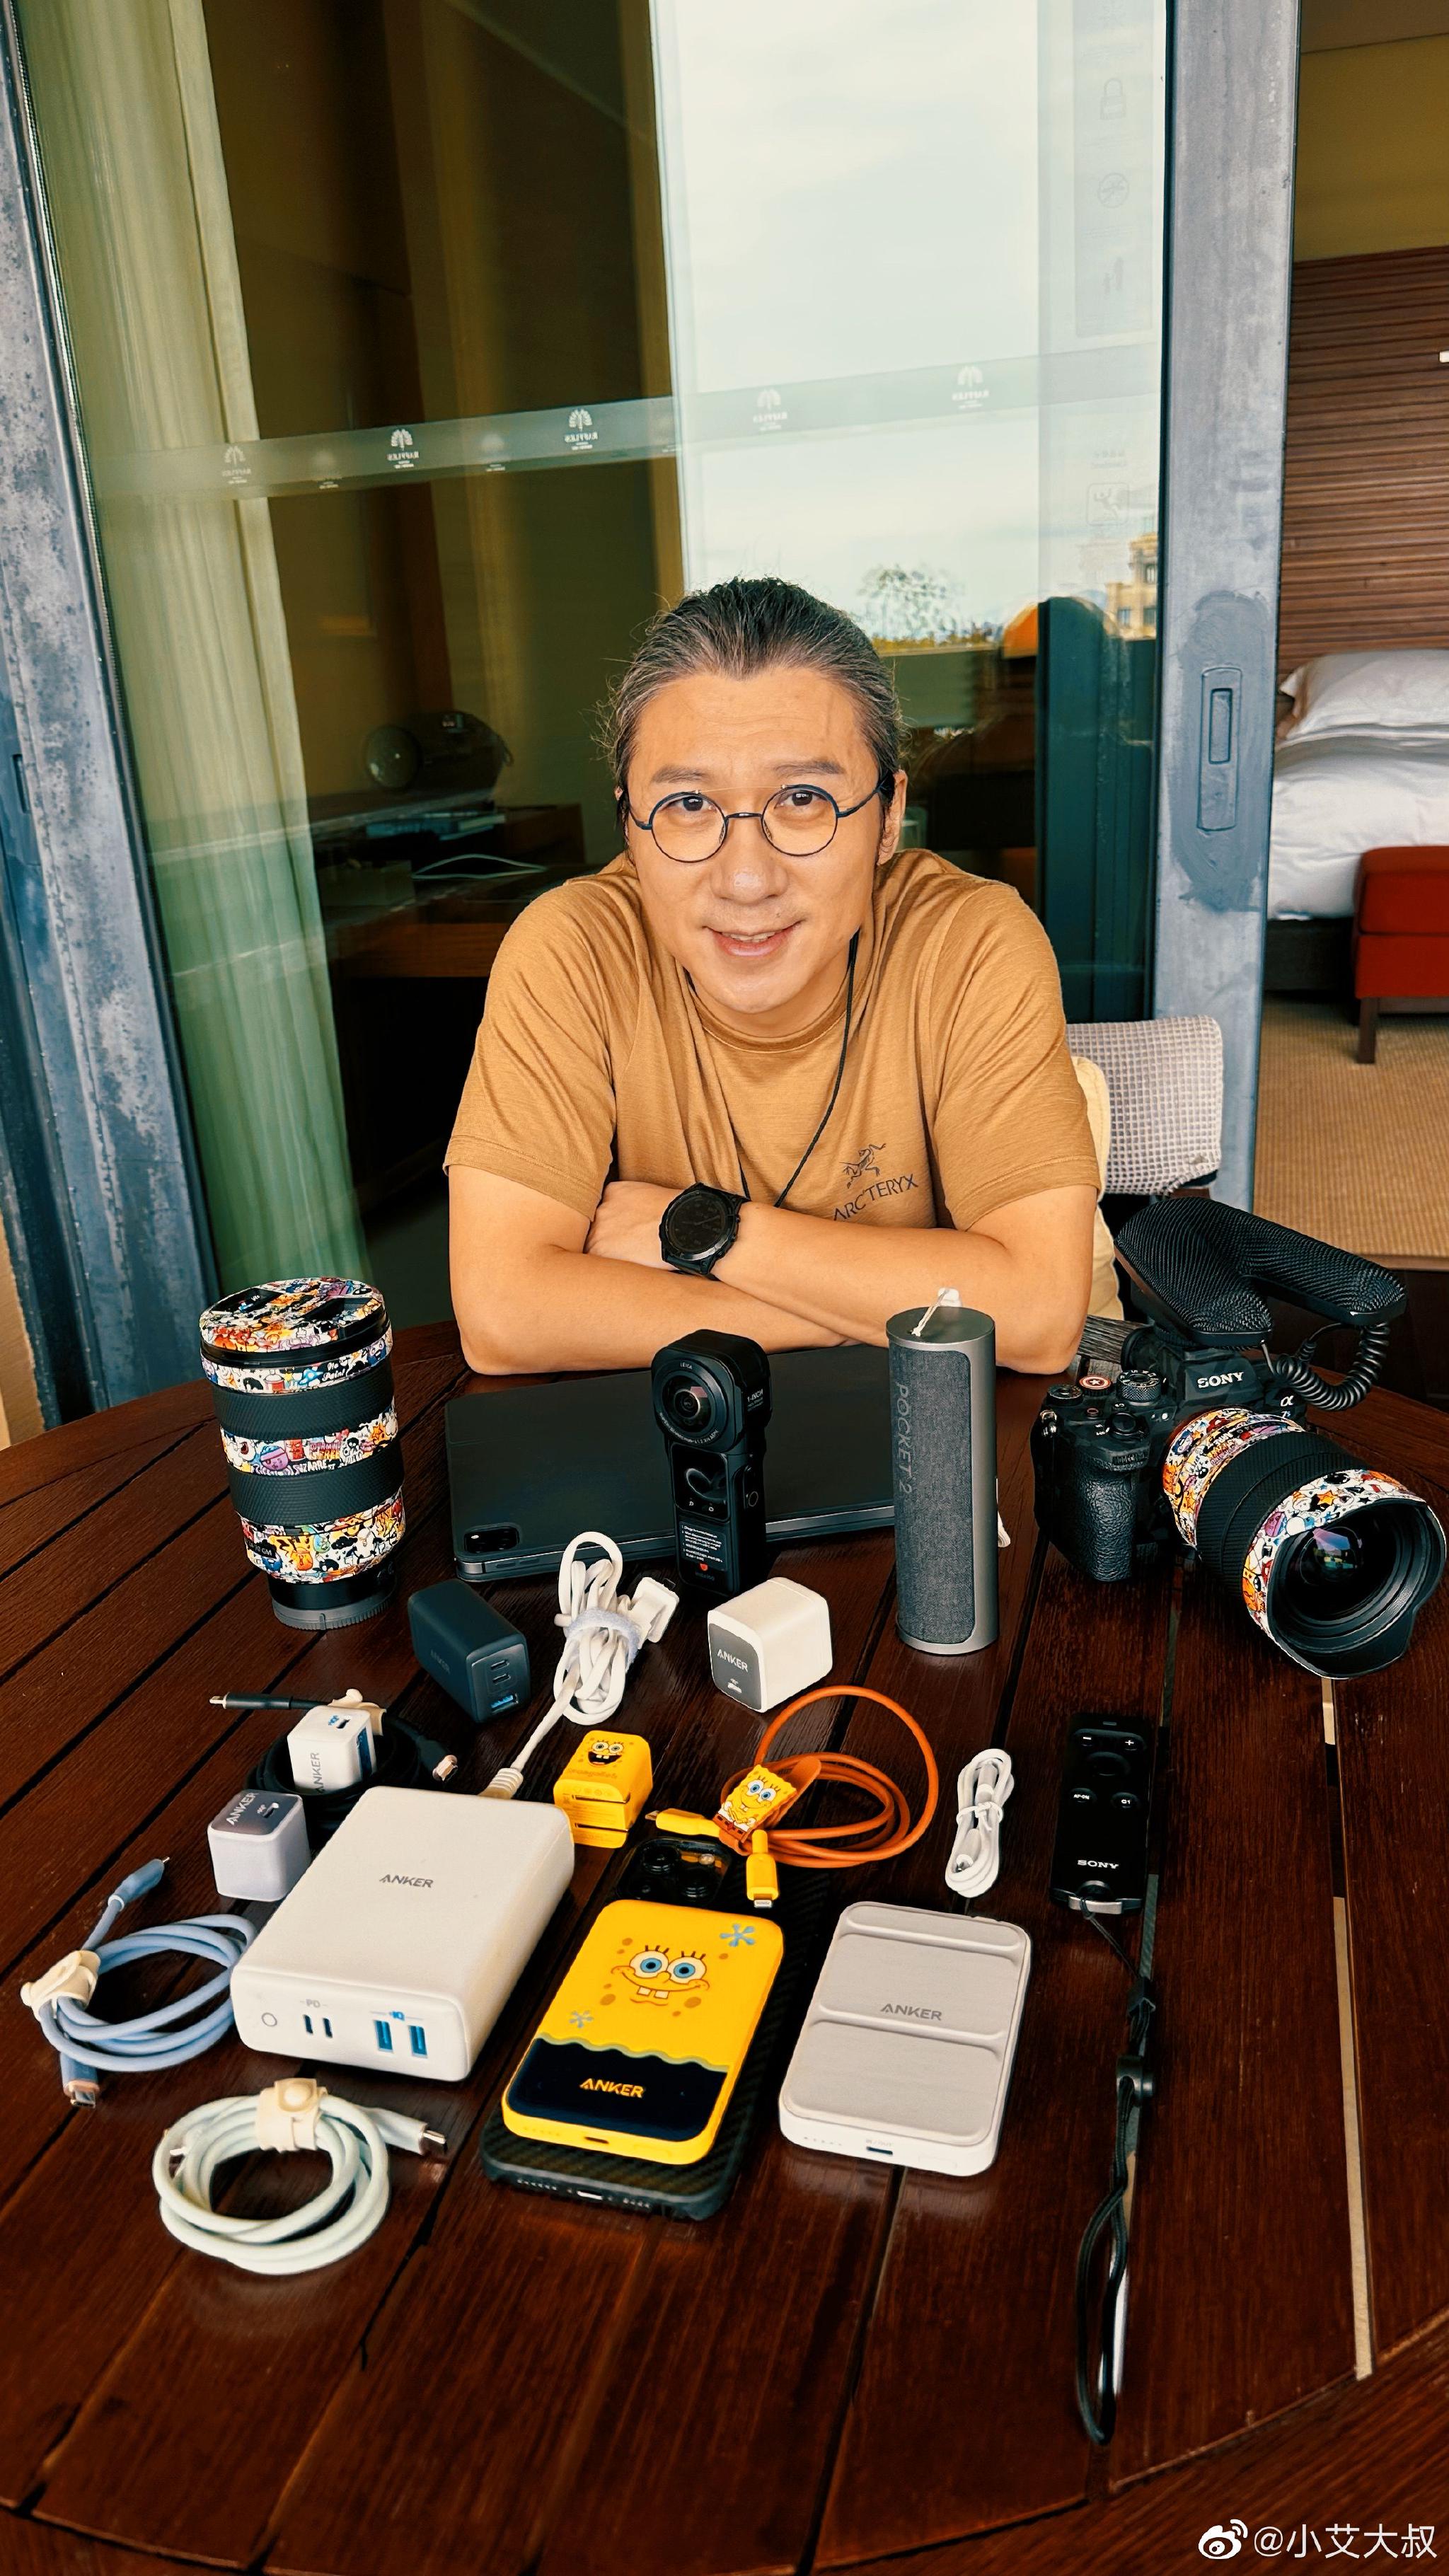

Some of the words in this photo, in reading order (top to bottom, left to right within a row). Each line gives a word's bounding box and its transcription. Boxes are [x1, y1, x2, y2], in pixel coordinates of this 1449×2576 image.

[1197, 1371, 1245, 1389] SONY
[747, 1388, 763, 1402] 1-INCH
[895, 1381, 913, 1478] POCKET
[899, 1481, 913, 1494] 2
[261, 1547, 272, 1556] GM
[717, 1648, 749, 1673] ANKER
[310, 1752, 325, 1794] ANKER
[226, 1792, 259, 1826] ANKER
[1077, 1859, 1119, 1869] SONY
[379, 1873, 434, 1889] ANKER
[879, 2003, 943, 2022] ANKER
[579, 2077, 646, 2100] ANKER
